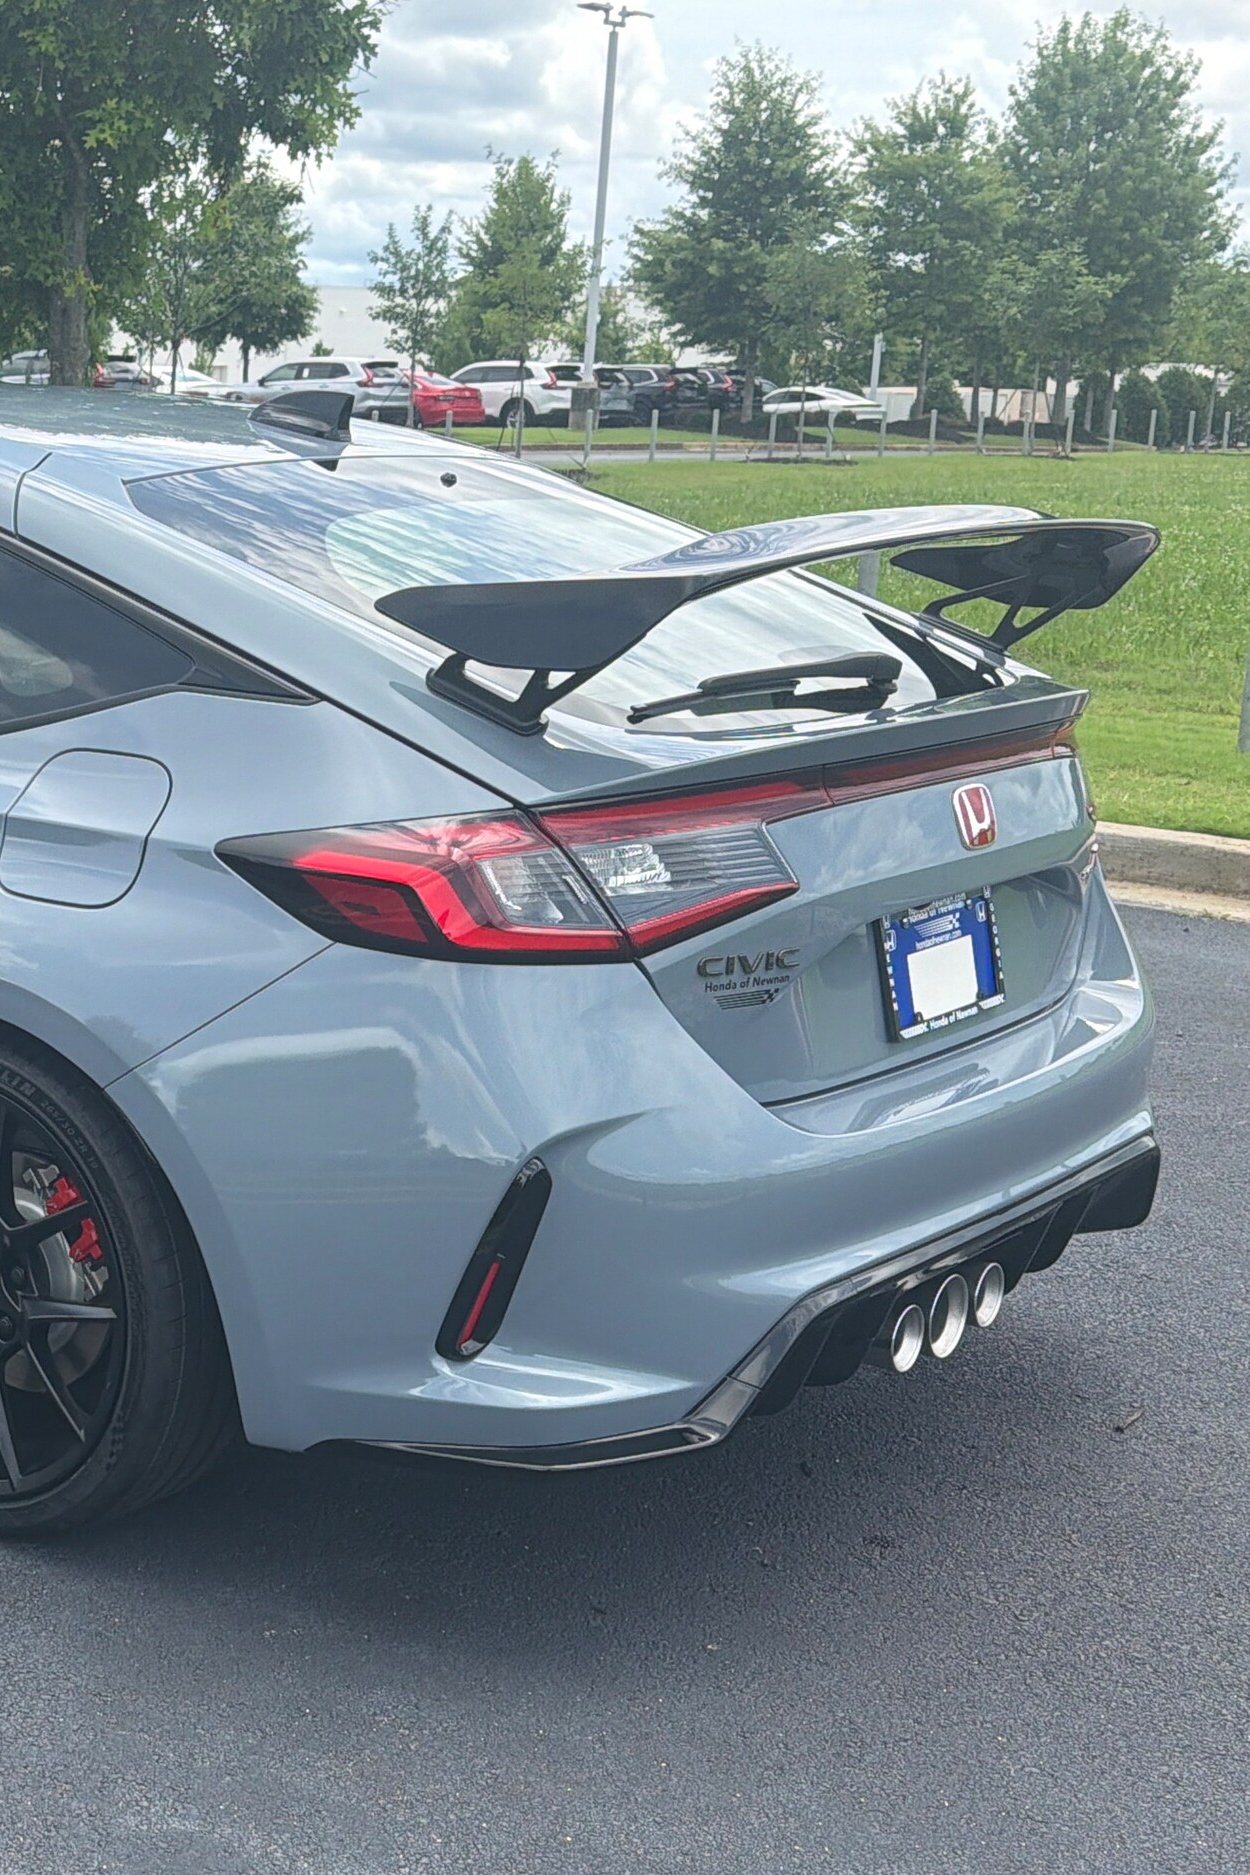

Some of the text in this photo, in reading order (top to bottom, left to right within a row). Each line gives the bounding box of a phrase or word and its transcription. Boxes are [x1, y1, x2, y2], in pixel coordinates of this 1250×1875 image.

[697, 946, 800, 978] CIVIC
[705, 975, 790, 992] Honda of Newnan
[929, 1015, 948, 1030] Honda
